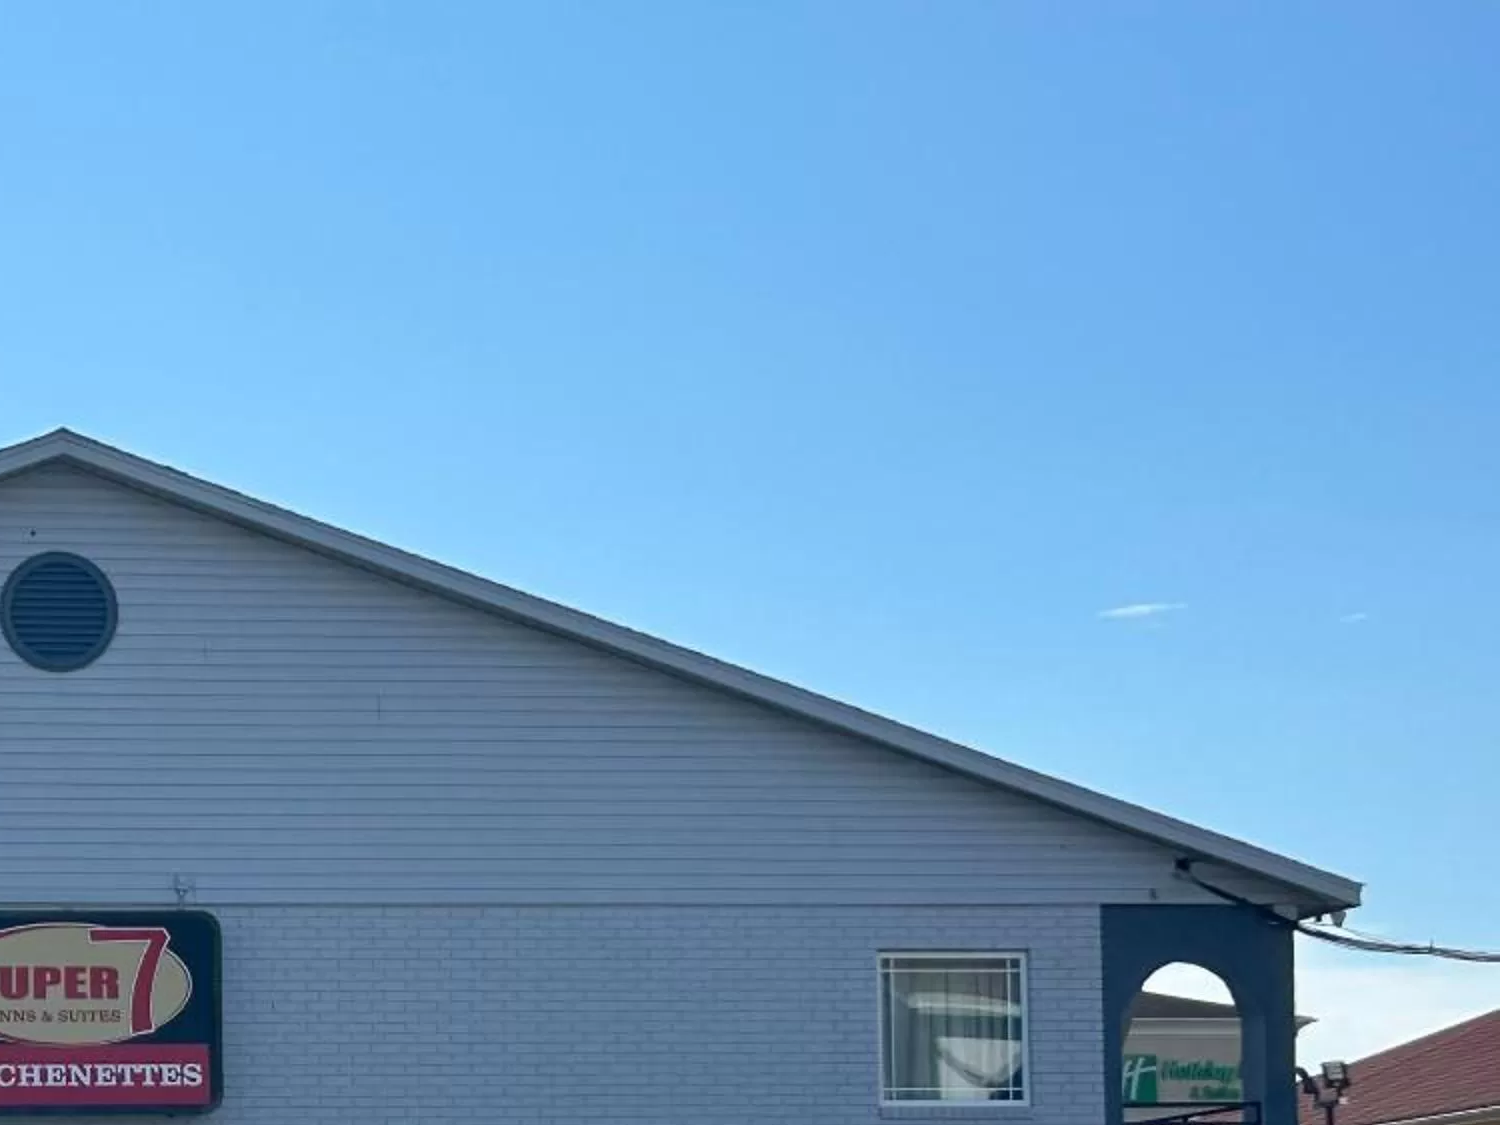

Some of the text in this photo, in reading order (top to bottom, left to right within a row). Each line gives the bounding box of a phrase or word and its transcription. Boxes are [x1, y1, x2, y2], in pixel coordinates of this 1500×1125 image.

[88, 927, 171, 1036] 7
[40, 1009, 53, 1023] &
[58, 1009, 122, 1023] SUITES
